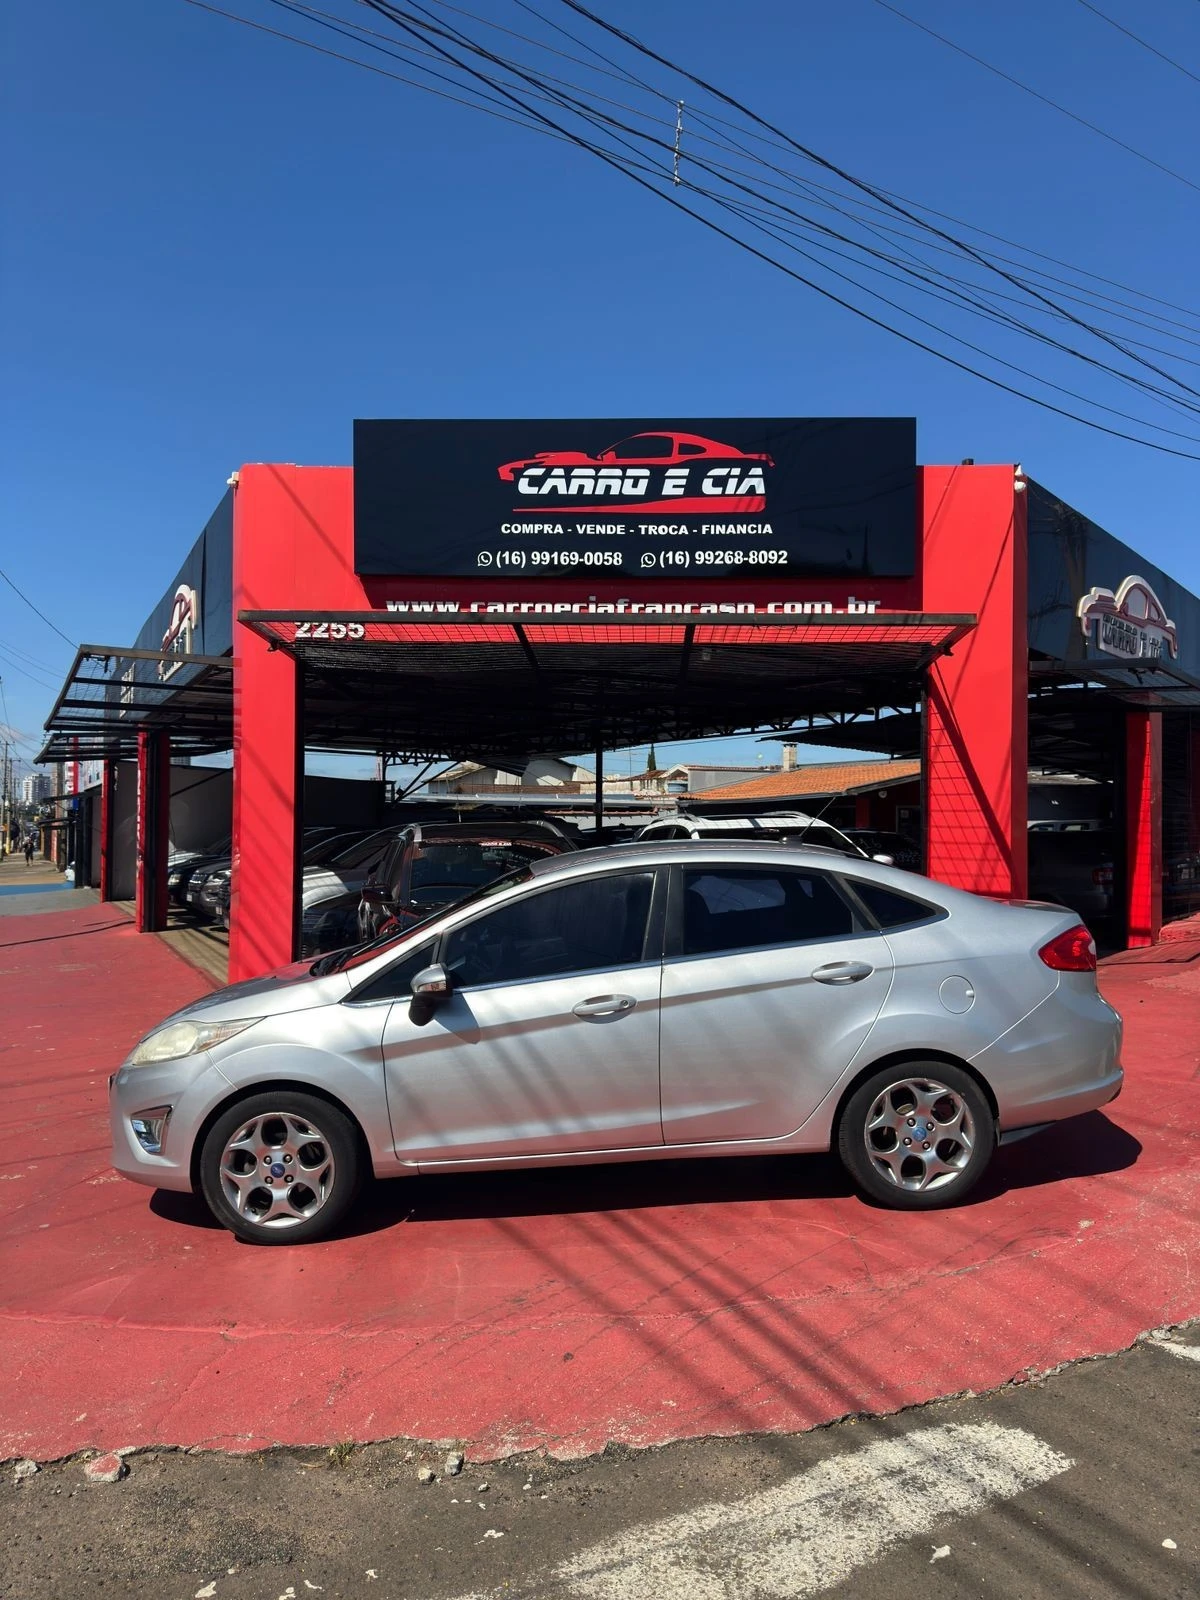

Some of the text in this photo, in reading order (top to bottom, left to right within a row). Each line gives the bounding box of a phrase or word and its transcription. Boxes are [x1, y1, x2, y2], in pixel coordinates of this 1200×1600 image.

[517, 467, 766, 496] CARRO E CIA
[500, 523, 564, 535] COMPRA
[576, 524, 626, 535] VENDE
[638, 524, 689, 536] TROCA
[701, 523, 773, 535] FINANCIA
[496, 550, 623, 568] (16) 99169-0058
[659, 550, 788, 568] (16) 99268-8092
[294, 622, 365, 639] 2255
